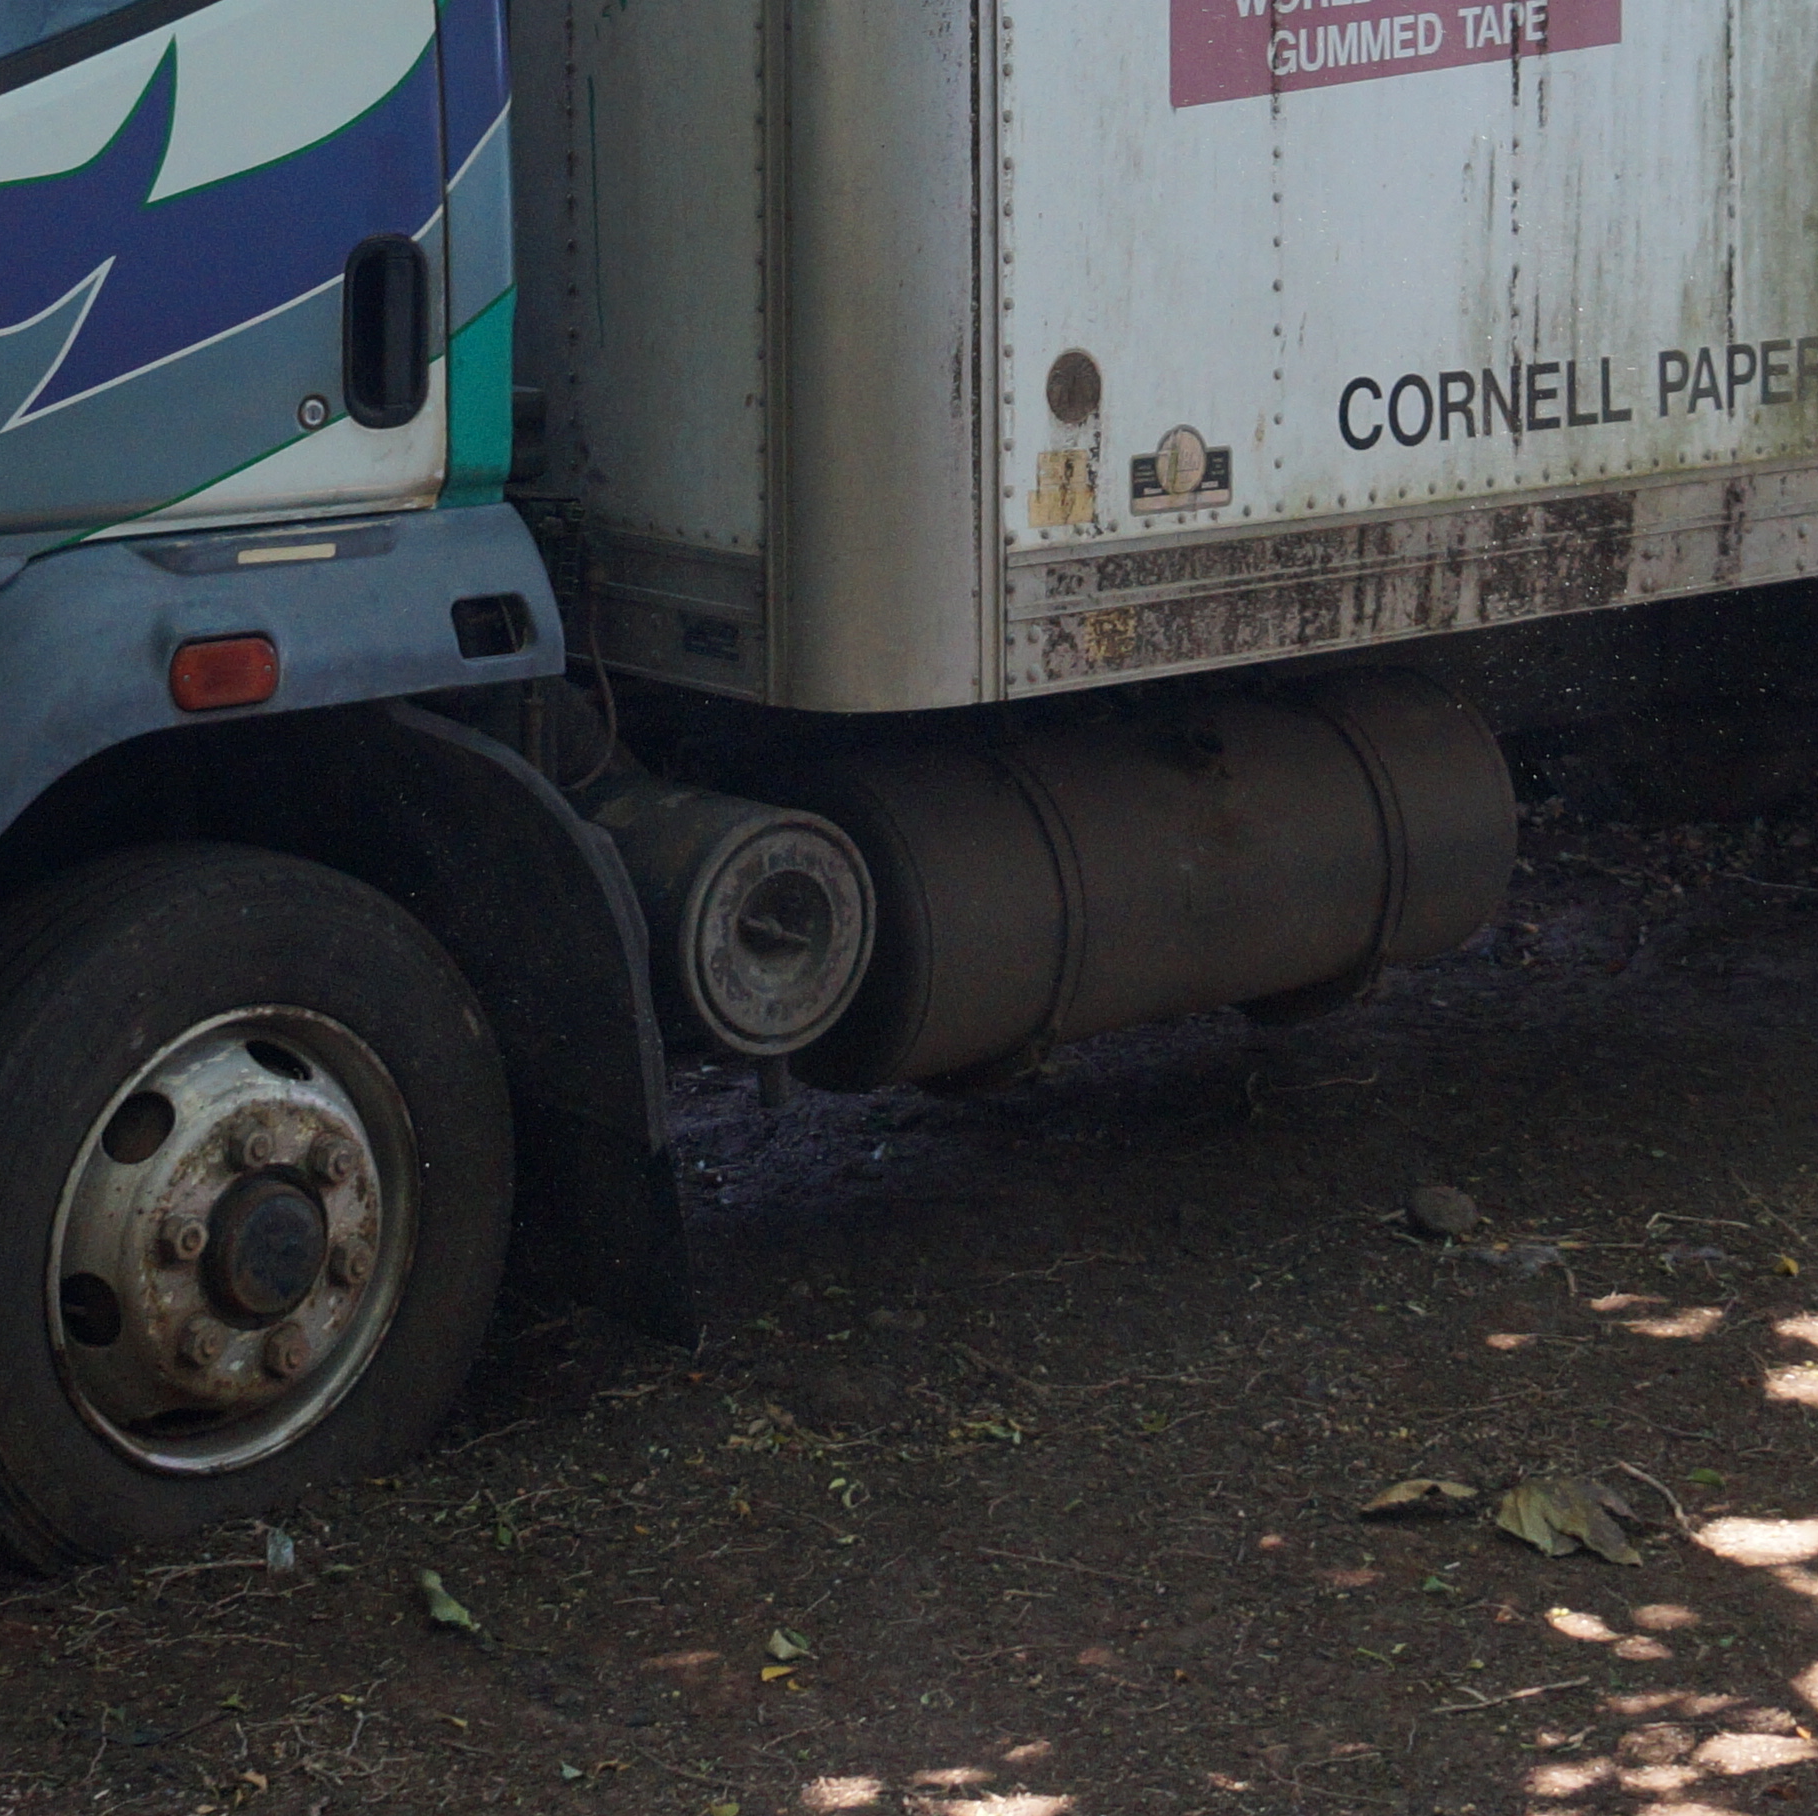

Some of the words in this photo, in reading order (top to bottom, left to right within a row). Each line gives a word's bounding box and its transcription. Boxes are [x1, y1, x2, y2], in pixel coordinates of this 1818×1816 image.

[1267, 12, 1443, 75] GUMMED
[1459, 0, 1549, 49] TAPE
[1338, 357, 1632, 450] CORNELL
